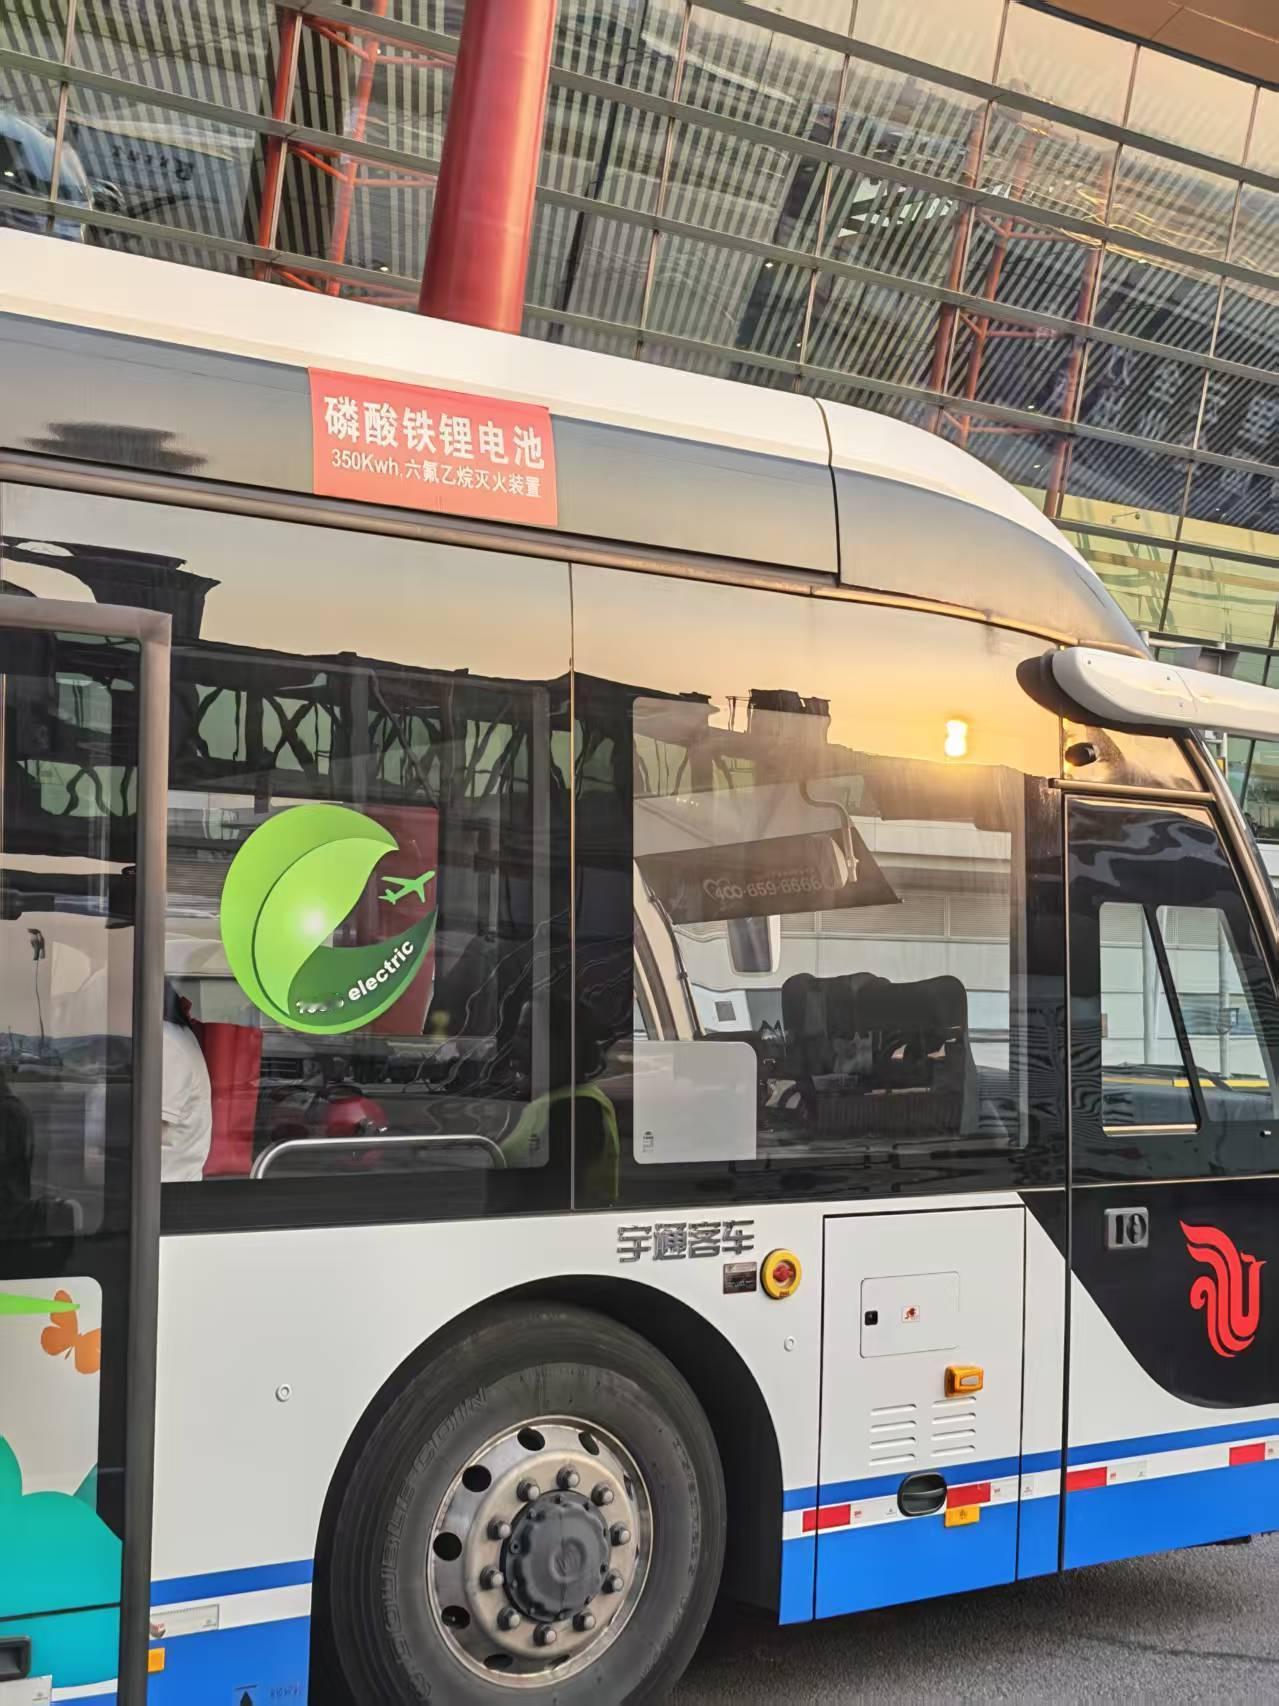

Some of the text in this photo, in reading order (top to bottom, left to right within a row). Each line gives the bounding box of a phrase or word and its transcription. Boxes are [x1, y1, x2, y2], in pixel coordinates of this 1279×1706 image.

[324, 396, 544, 469] 磷酸铁锂电池
[348, 941, 415, 1001] electric
[617, 1219, 754, 1263] 宇通客车
